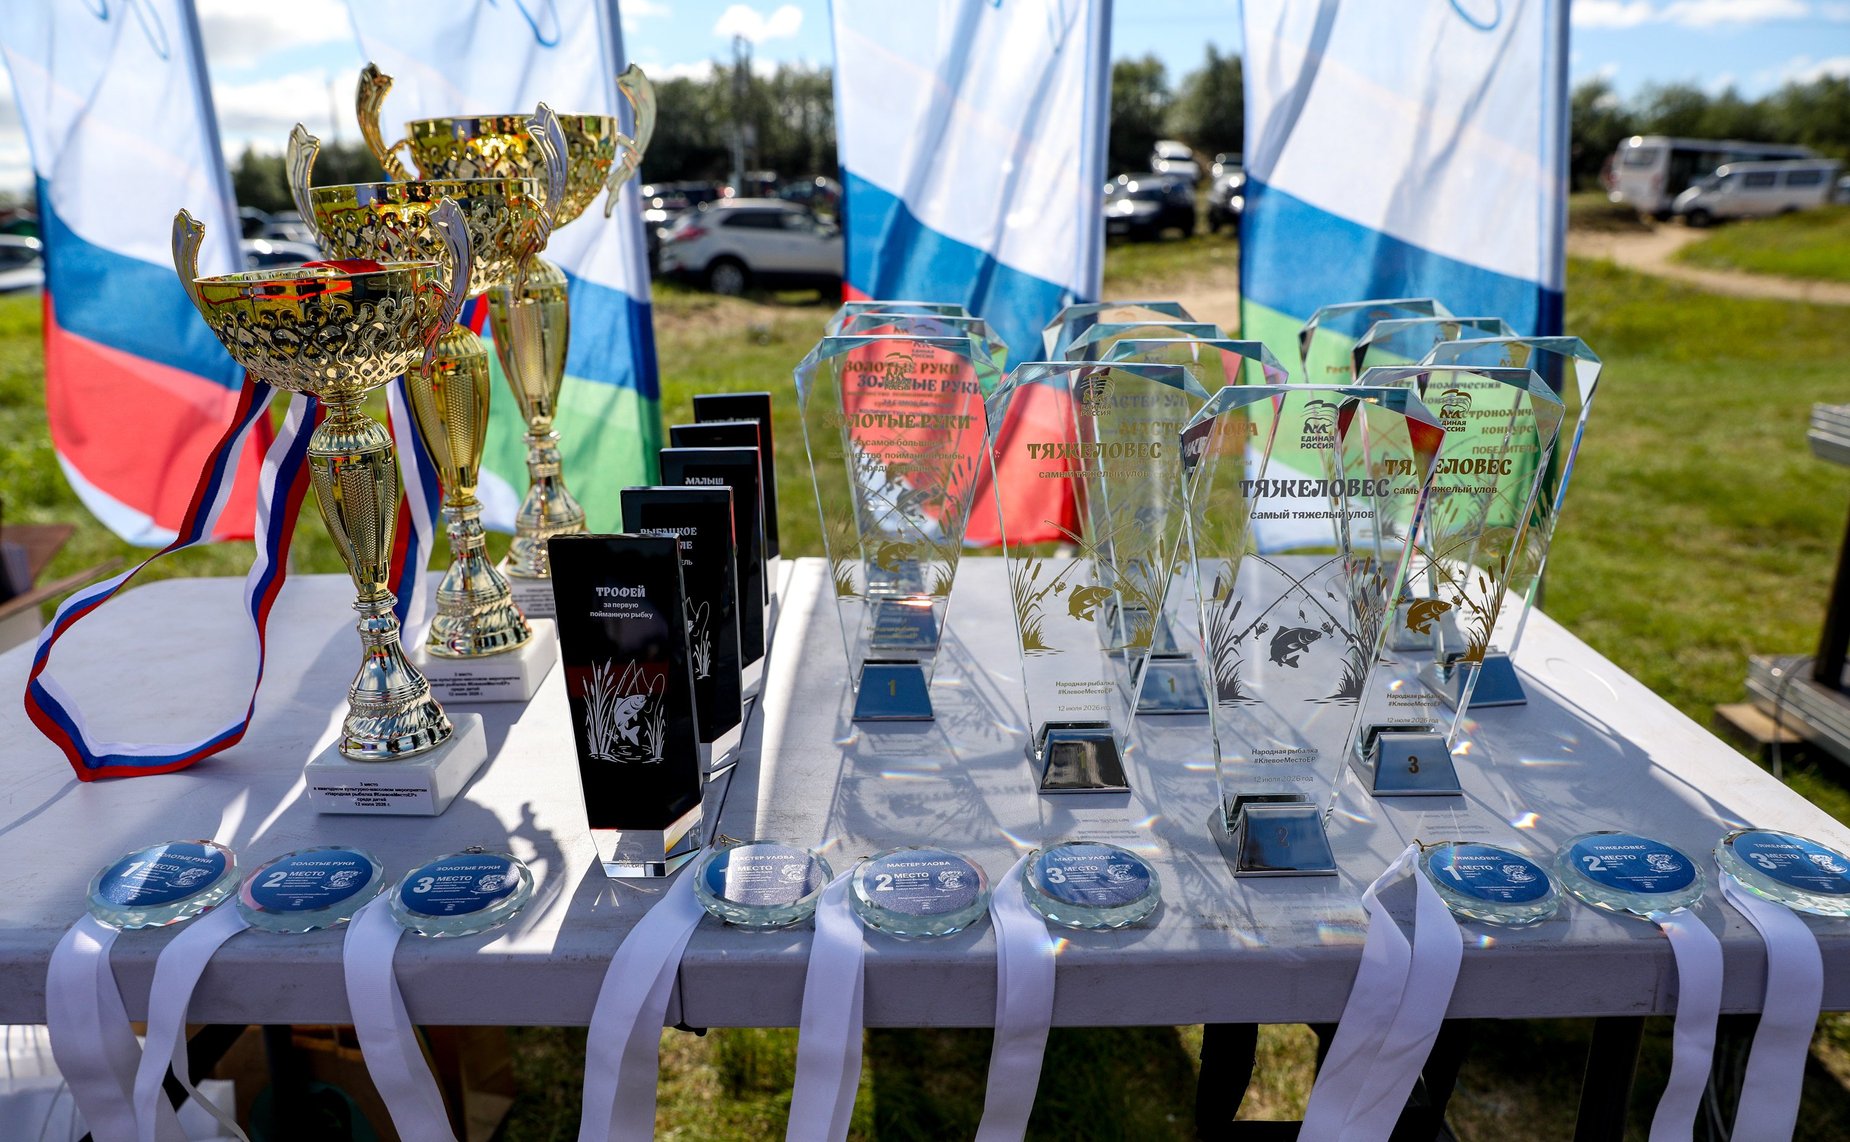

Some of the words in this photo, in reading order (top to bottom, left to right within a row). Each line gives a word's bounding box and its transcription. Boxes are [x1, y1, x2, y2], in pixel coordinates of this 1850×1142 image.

[857, 374, 938, 392] ЗОЛТЫЕ
[823, 410, 917, 429] ЗОЛОТЫЕ
[920, 414, 971, 430] РУКИ
[1300, 435, 1335, 443] ЕДИНАЯ
[1027, 442, 1162, 460] ТЯЖЕЛОВЕС
[1039, 469, 1074, 479] самый
[1125, 471, 1150, 481] улов
[1384, 458, 1513, 477] ТЯЕЛОВЕС
[685, 477, 724, 485] МАЛЫШ
[1239, 478, 1390, 499] ТЯЖЕЛОВЕС
[1393, 486, 1420, 494] самы
[1431, 485, 1472, 494] яжелый
[1473, 486, 1498, 495] улов
[1250, 509, 1290, 519] самый
[1291, 509, 1346, 520] тяжелый
[1347, 510, 1375, 523] улов
[595, 585, 646, 598] ТРОФЕЙ
[589, 610, 630, 618] пойманную
[630, 611, 653, 619] рыбку
[888, 679, 896, 697] 1
[1087, 680, 1116, 688] рыбалка
[1167, 677, 1175, 694] 1
[1251, 748, 1287, 756] Народная
[1287, 748, 1319, 756] рыбалка
[1407, 756, 1420, 774] 3
[191, 856, 214, 864] РУКИ
[1582, 855, 1608, 872] 2
[1749, 853, 1778, 870] 3
[120, 861, 145, 878] 1
[146, 862, 180, 872] МЕСТО
[1045, 867, 1066, 884] 3
[1442, 865, 1463, 881] 1
[262, 871, 288, 888] 2
[413, 876, 435, 894] 3
[875, 873, 894, 892] 2
